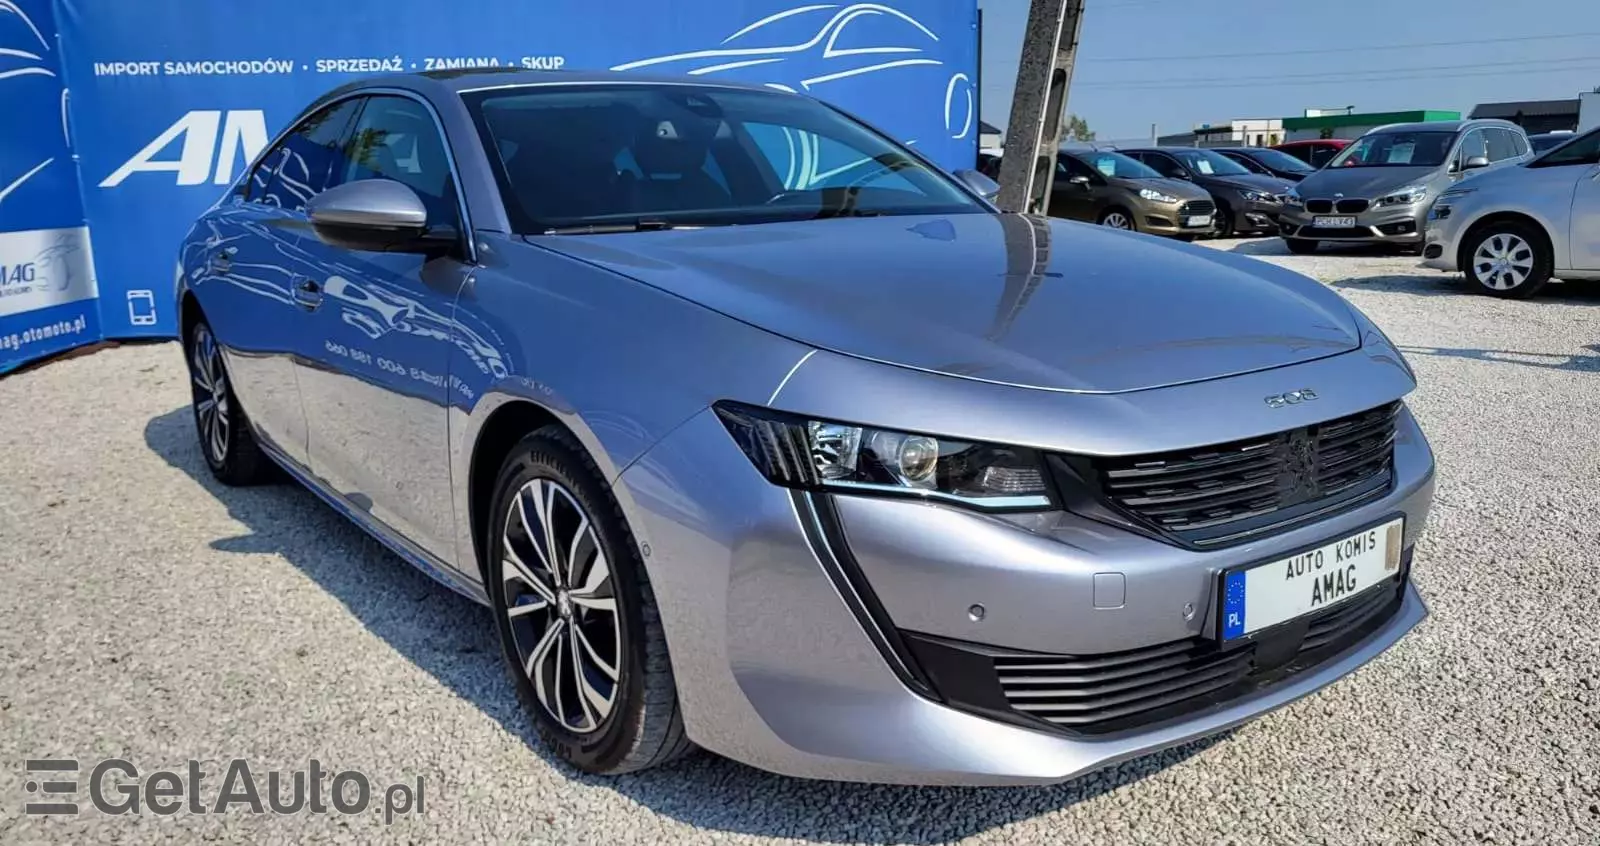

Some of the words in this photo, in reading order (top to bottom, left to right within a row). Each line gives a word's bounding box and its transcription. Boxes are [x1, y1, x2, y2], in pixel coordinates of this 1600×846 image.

[94, 61, 160, 76] IMPORT
[164, 58, 294, 75] SAMOCHODÓW
[315, 55, 403, 73] SPRZEDAŻ
[424, 57, 499, 71] ZAMIANA
[521, 56, 565, 70] SKUP
[1285, 549, 1324, 580] AUTO
[1335, 530, 1376, 563] KOMIS
[1310, 564, 1357, 607] AMAG
[1228, 612, 1241, 629] PL
